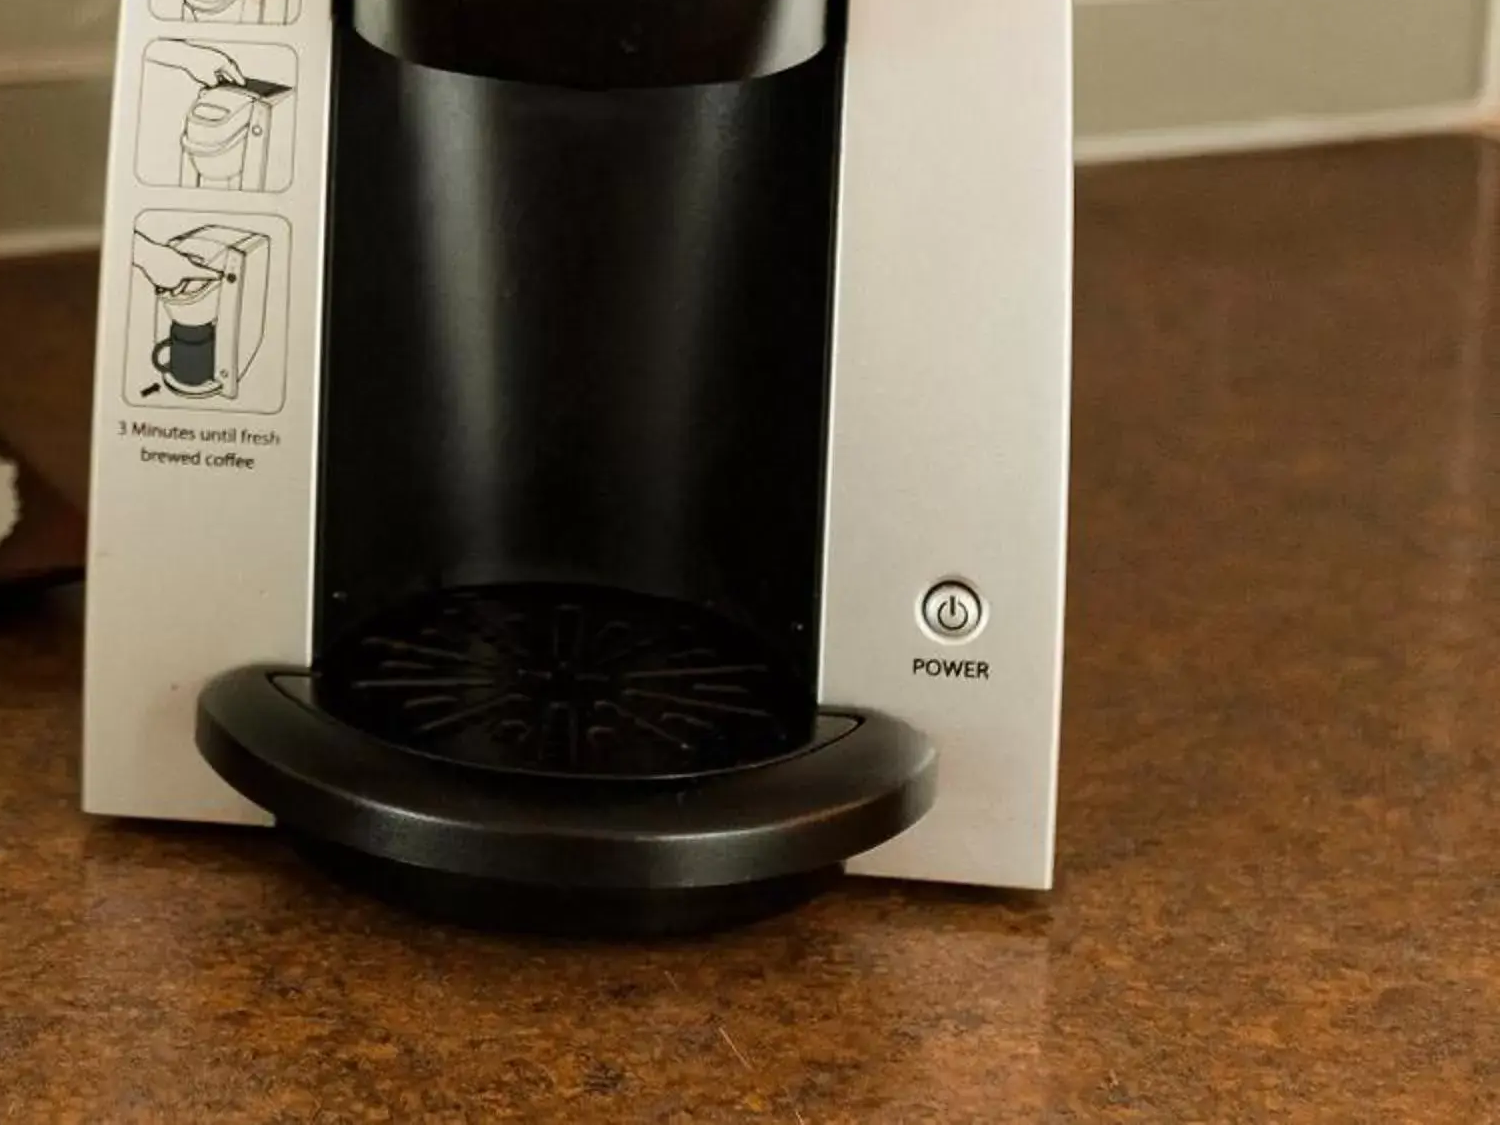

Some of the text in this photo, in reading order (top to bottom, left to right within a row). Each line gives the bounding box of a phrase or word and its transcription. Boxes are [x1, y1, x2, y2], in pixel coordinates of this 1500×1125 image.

[117, 420, 281, 446] 3 Minutes until fresh
[140, 446, 256, 470] brewed coffee
[912, 658, 991, 680] POWER
